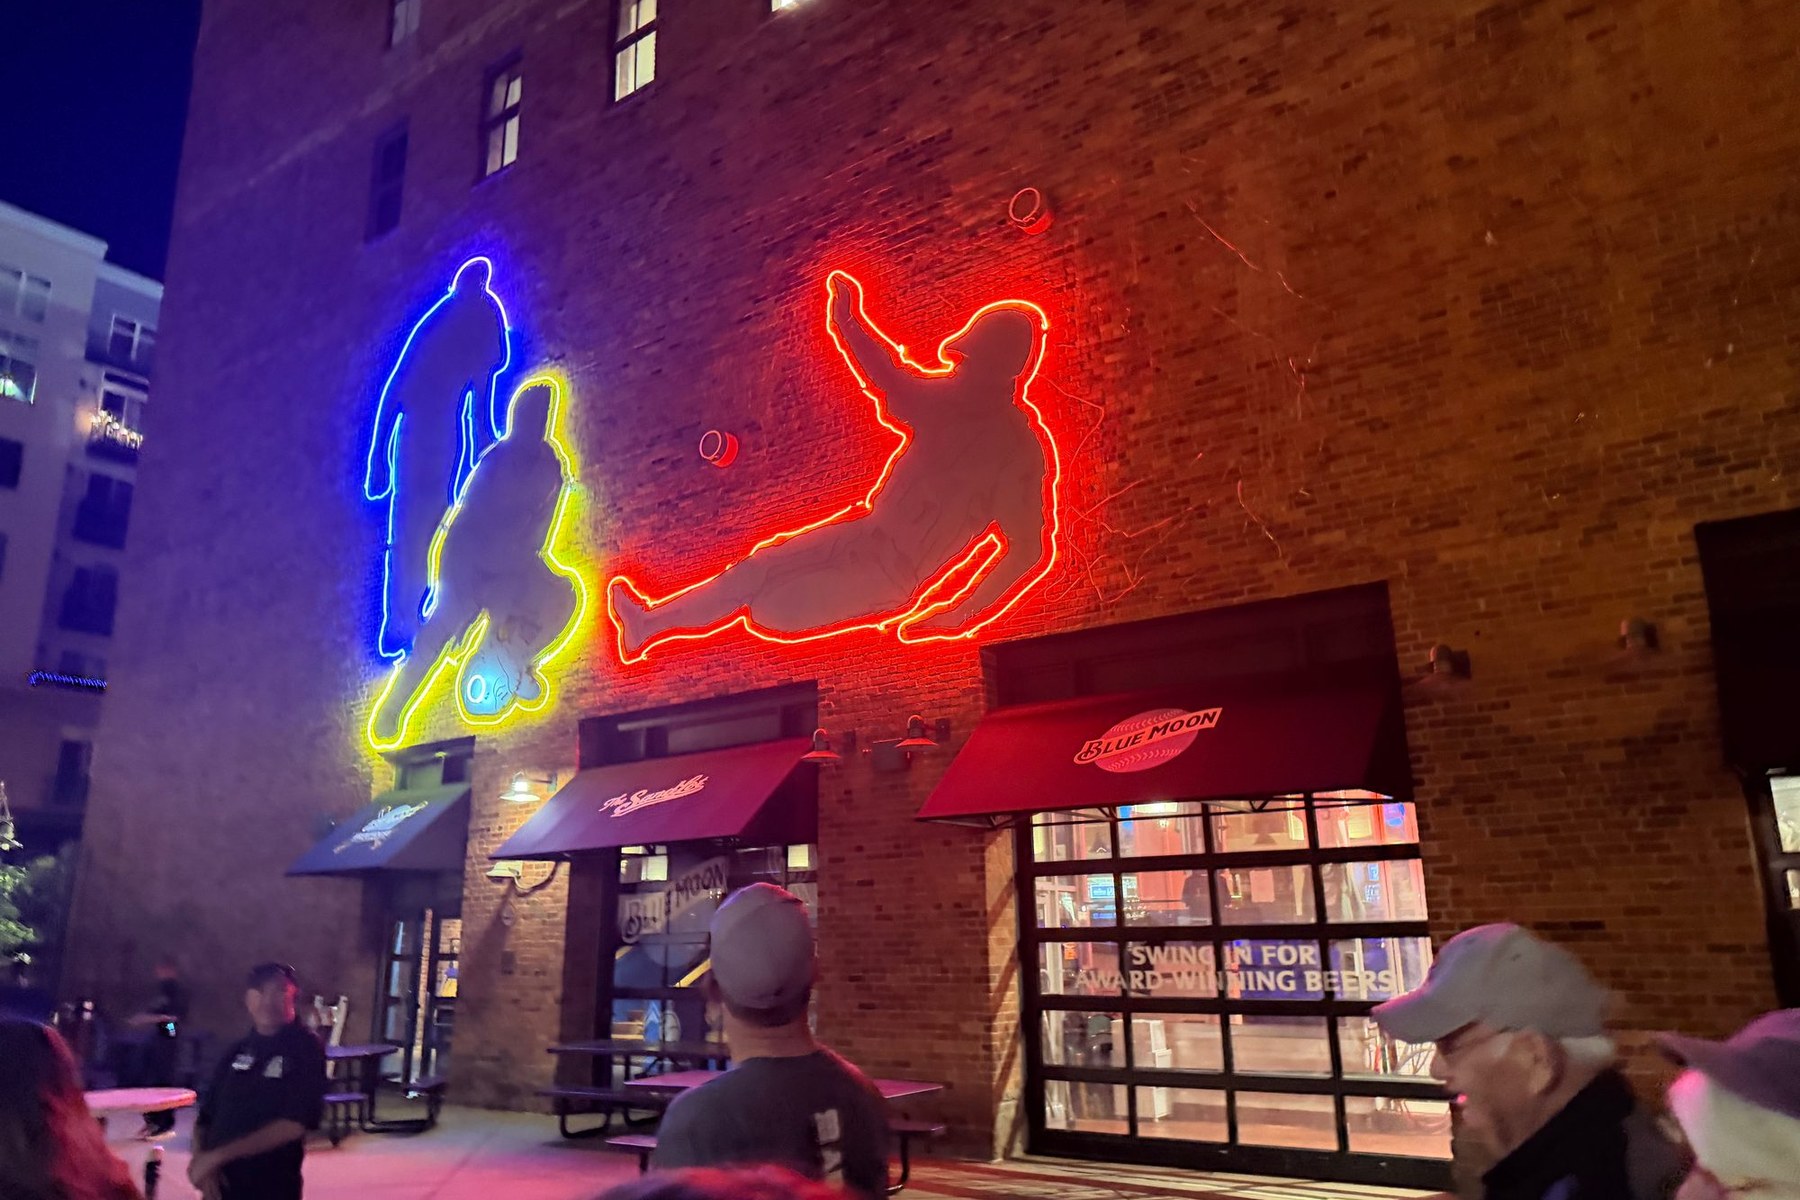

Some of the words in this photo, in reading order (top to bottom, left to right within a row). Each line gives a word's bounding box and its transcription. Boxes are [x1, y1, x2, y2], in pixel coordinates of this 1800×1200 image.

[1076, 730, 1146, 762] BLUE
[1147, 710, 1218, 740] MOON
[1131, 945, 1214, 966] SWING
[1224, 945, 1253, 966] IN
[1261, 945, 1317, 966] FOR
[1074, 969, 1297, 993] AWARD-WINNING
[1303, 969, 1397, 993] BEERS
